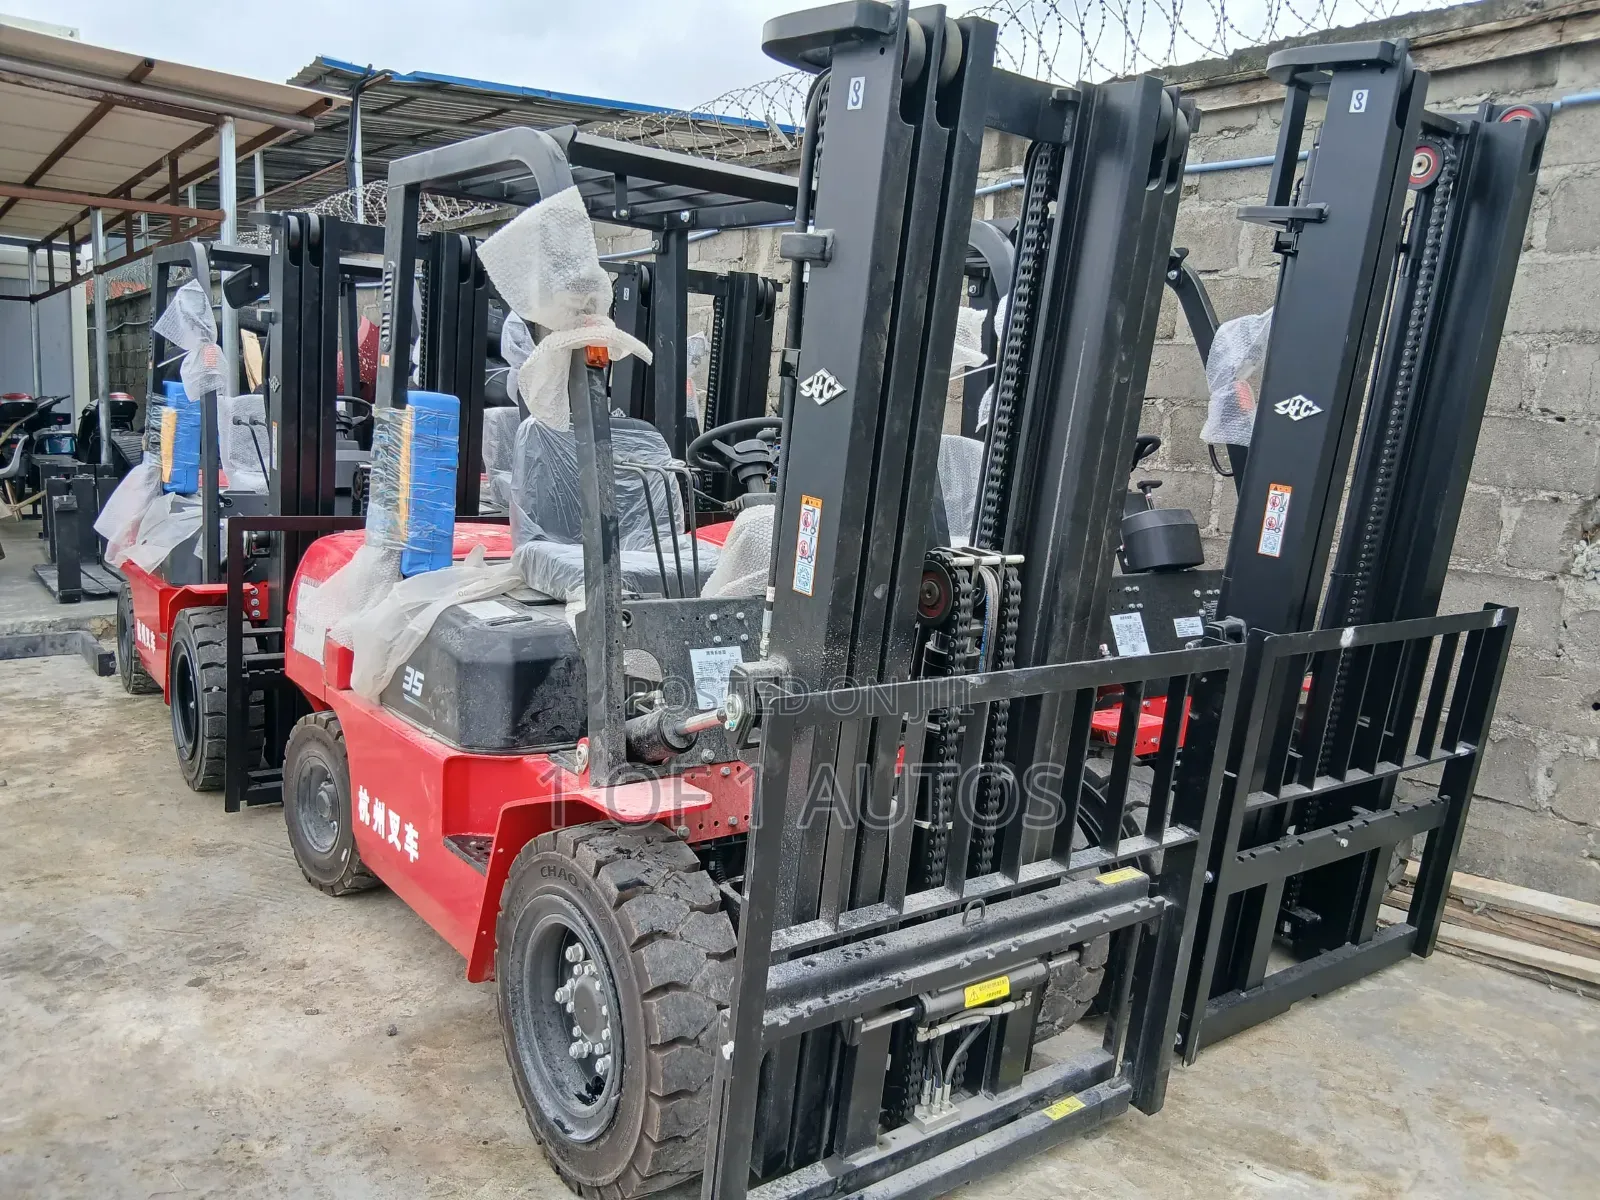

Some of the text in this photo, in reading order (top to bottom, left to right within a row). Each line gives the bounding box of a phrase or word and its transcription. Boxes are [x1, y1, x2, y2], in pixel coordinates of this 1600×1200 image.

[402, 665, 425, 697] 35
[358, 784, 419, 863] 杭州叉车
